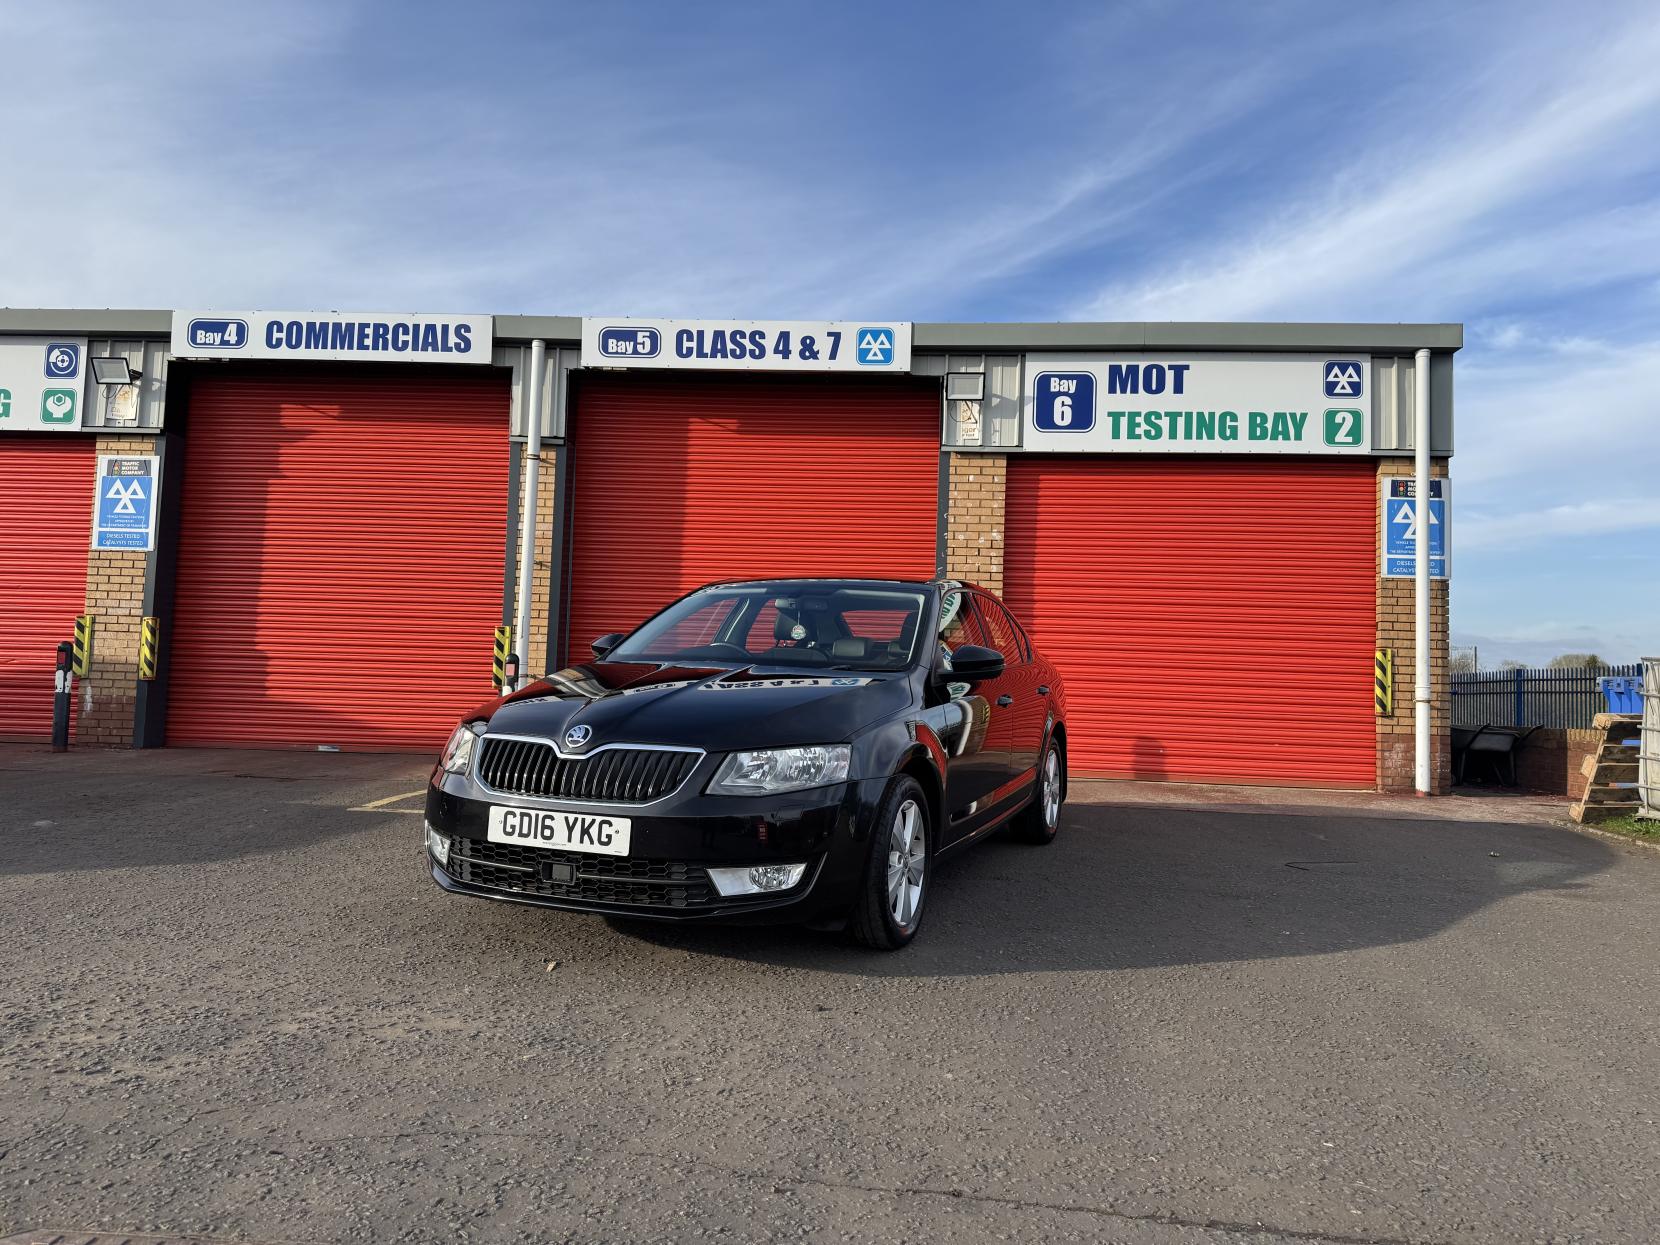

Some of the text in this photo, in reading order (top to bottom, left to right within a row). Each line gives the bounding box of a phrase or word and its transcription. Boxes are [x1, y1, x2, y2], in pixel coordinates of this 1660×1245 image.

[196, 323, 238, 346] Bay 4
[265, 320, 472, 353] COMMERCIALS
[607, 331, 651, 354] Bay 5
[675, 329, 842, 361] CLASS 4 & 7
[1050, 377, 1077, 394] Bay
[1107, 363, 1191, 395] MOT
[1053, 395, 1073, 427] 6
[1107, 411, 1309, 441] TESTING BAY
[1334, 411, 1354, 443] 2
[502, 810, 614, 847] GD16 YKG
